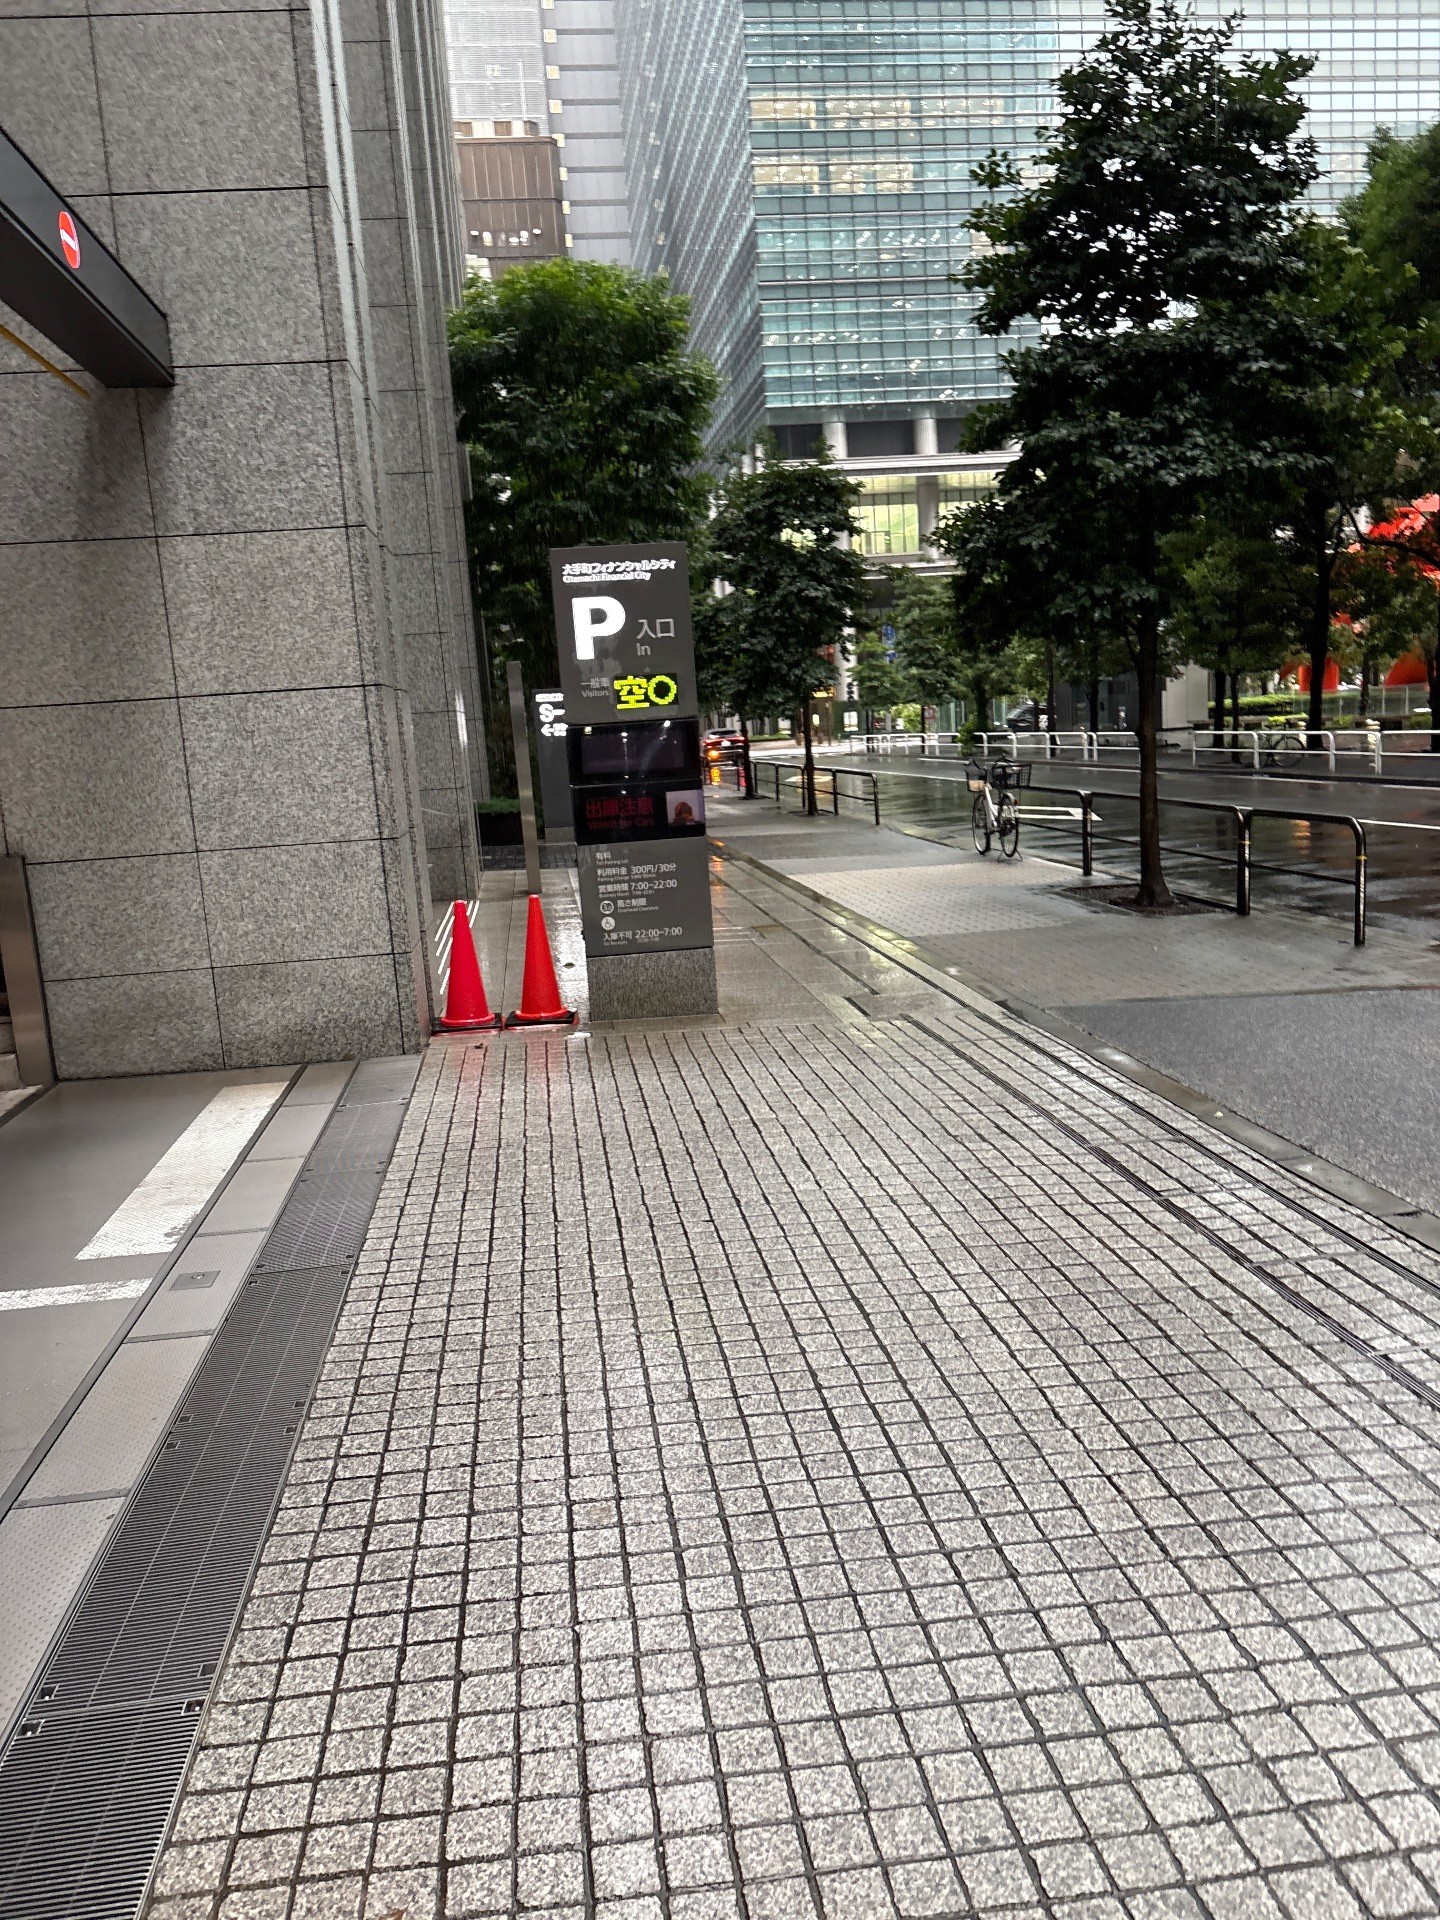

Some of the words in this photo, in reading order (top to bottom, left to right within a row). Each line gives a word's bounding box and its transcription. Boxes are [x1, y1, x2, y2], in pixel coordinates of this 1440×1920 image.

[562, 559, 676, 575] 大手町フィナンシャルシティ
[563, 573, 600, 583] Otemachi
[601, 572, 634, 582] Financial
[635, 571, 651, 581] City
[572, 596, 626, 660] P
[636, 618, 675, 639] 入口
[636, 643, 651, 656] In
[581, 677, 610, 689] 一般車
[581, 689, 609, 698] Visitors
[631, 863, 677, 875] 300円/30分
[617, 897, 647, 908] 高さ制限
